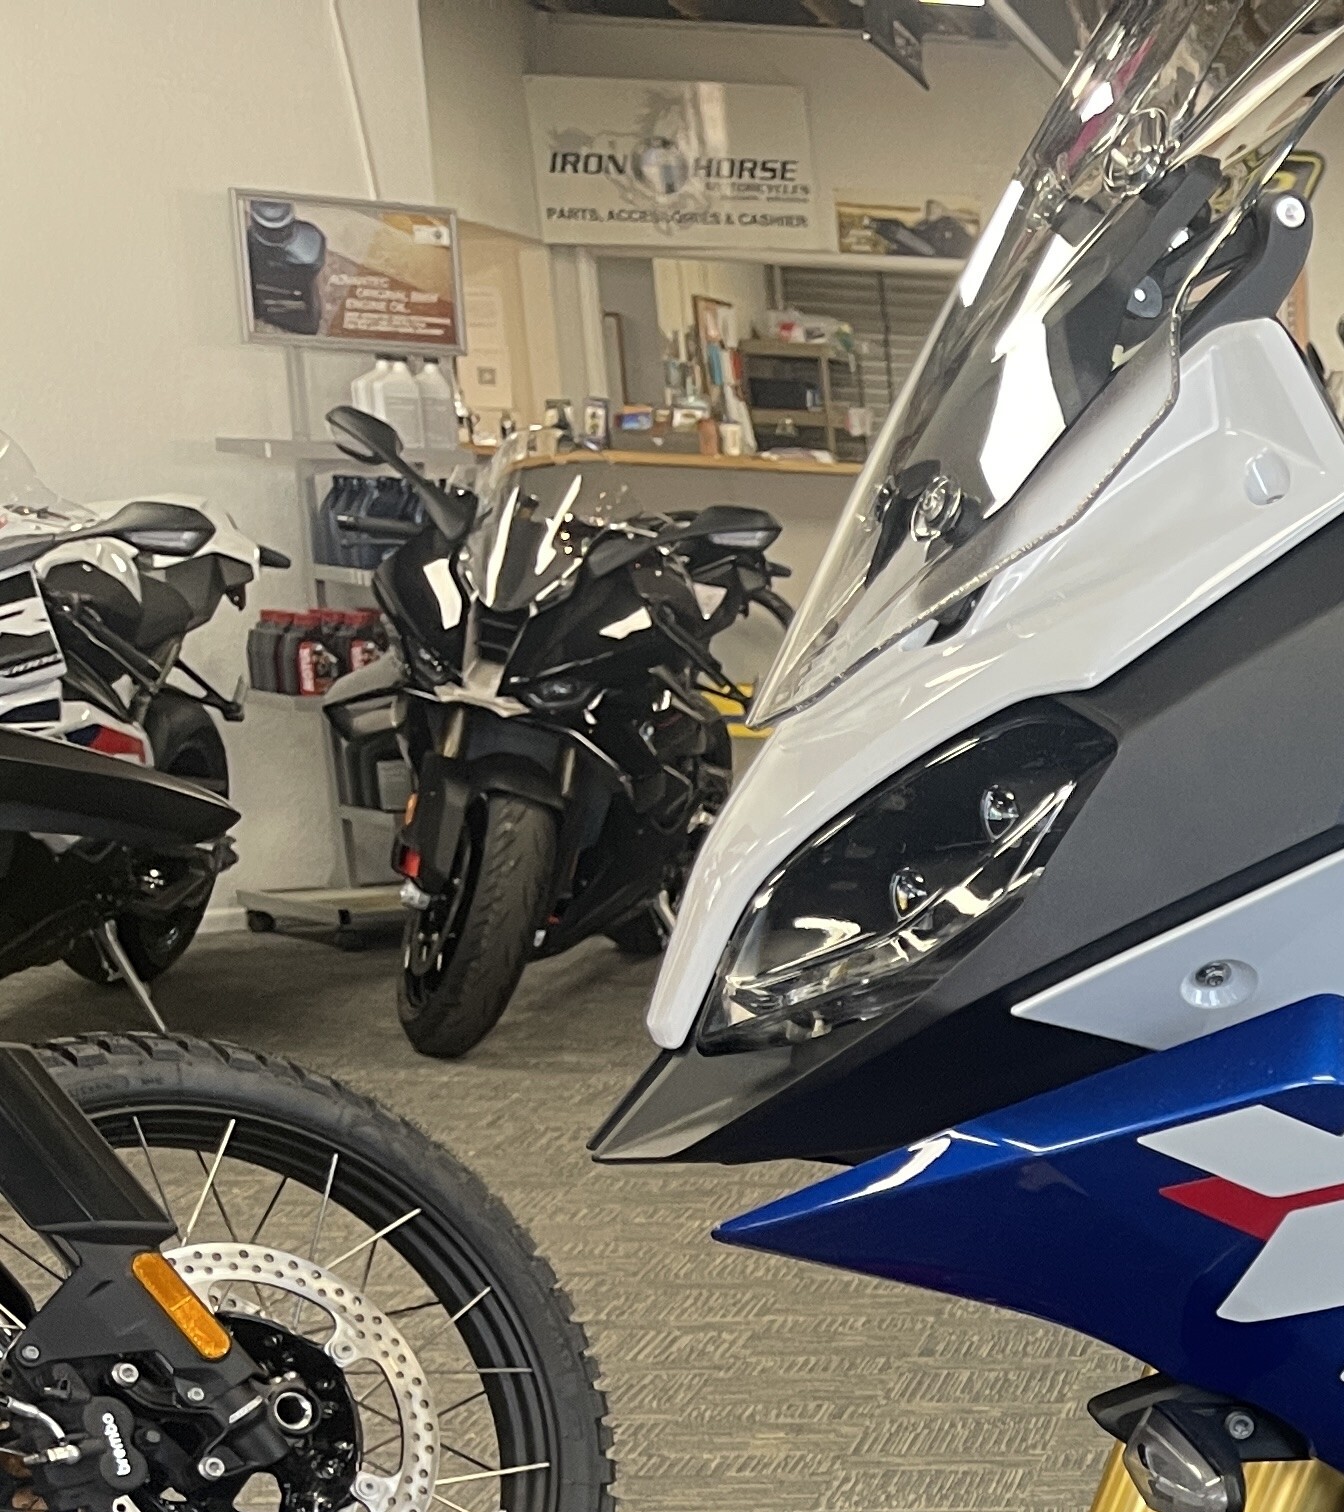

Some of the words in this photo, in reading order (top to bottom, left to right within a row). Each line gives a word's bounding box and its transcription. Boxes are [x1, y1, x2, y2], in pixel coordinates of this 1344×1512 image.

[548, 152, 627, 176] IRON
[694, 157, 799, 182] HORSE
[102, 1412, 132, 1476] brembo
